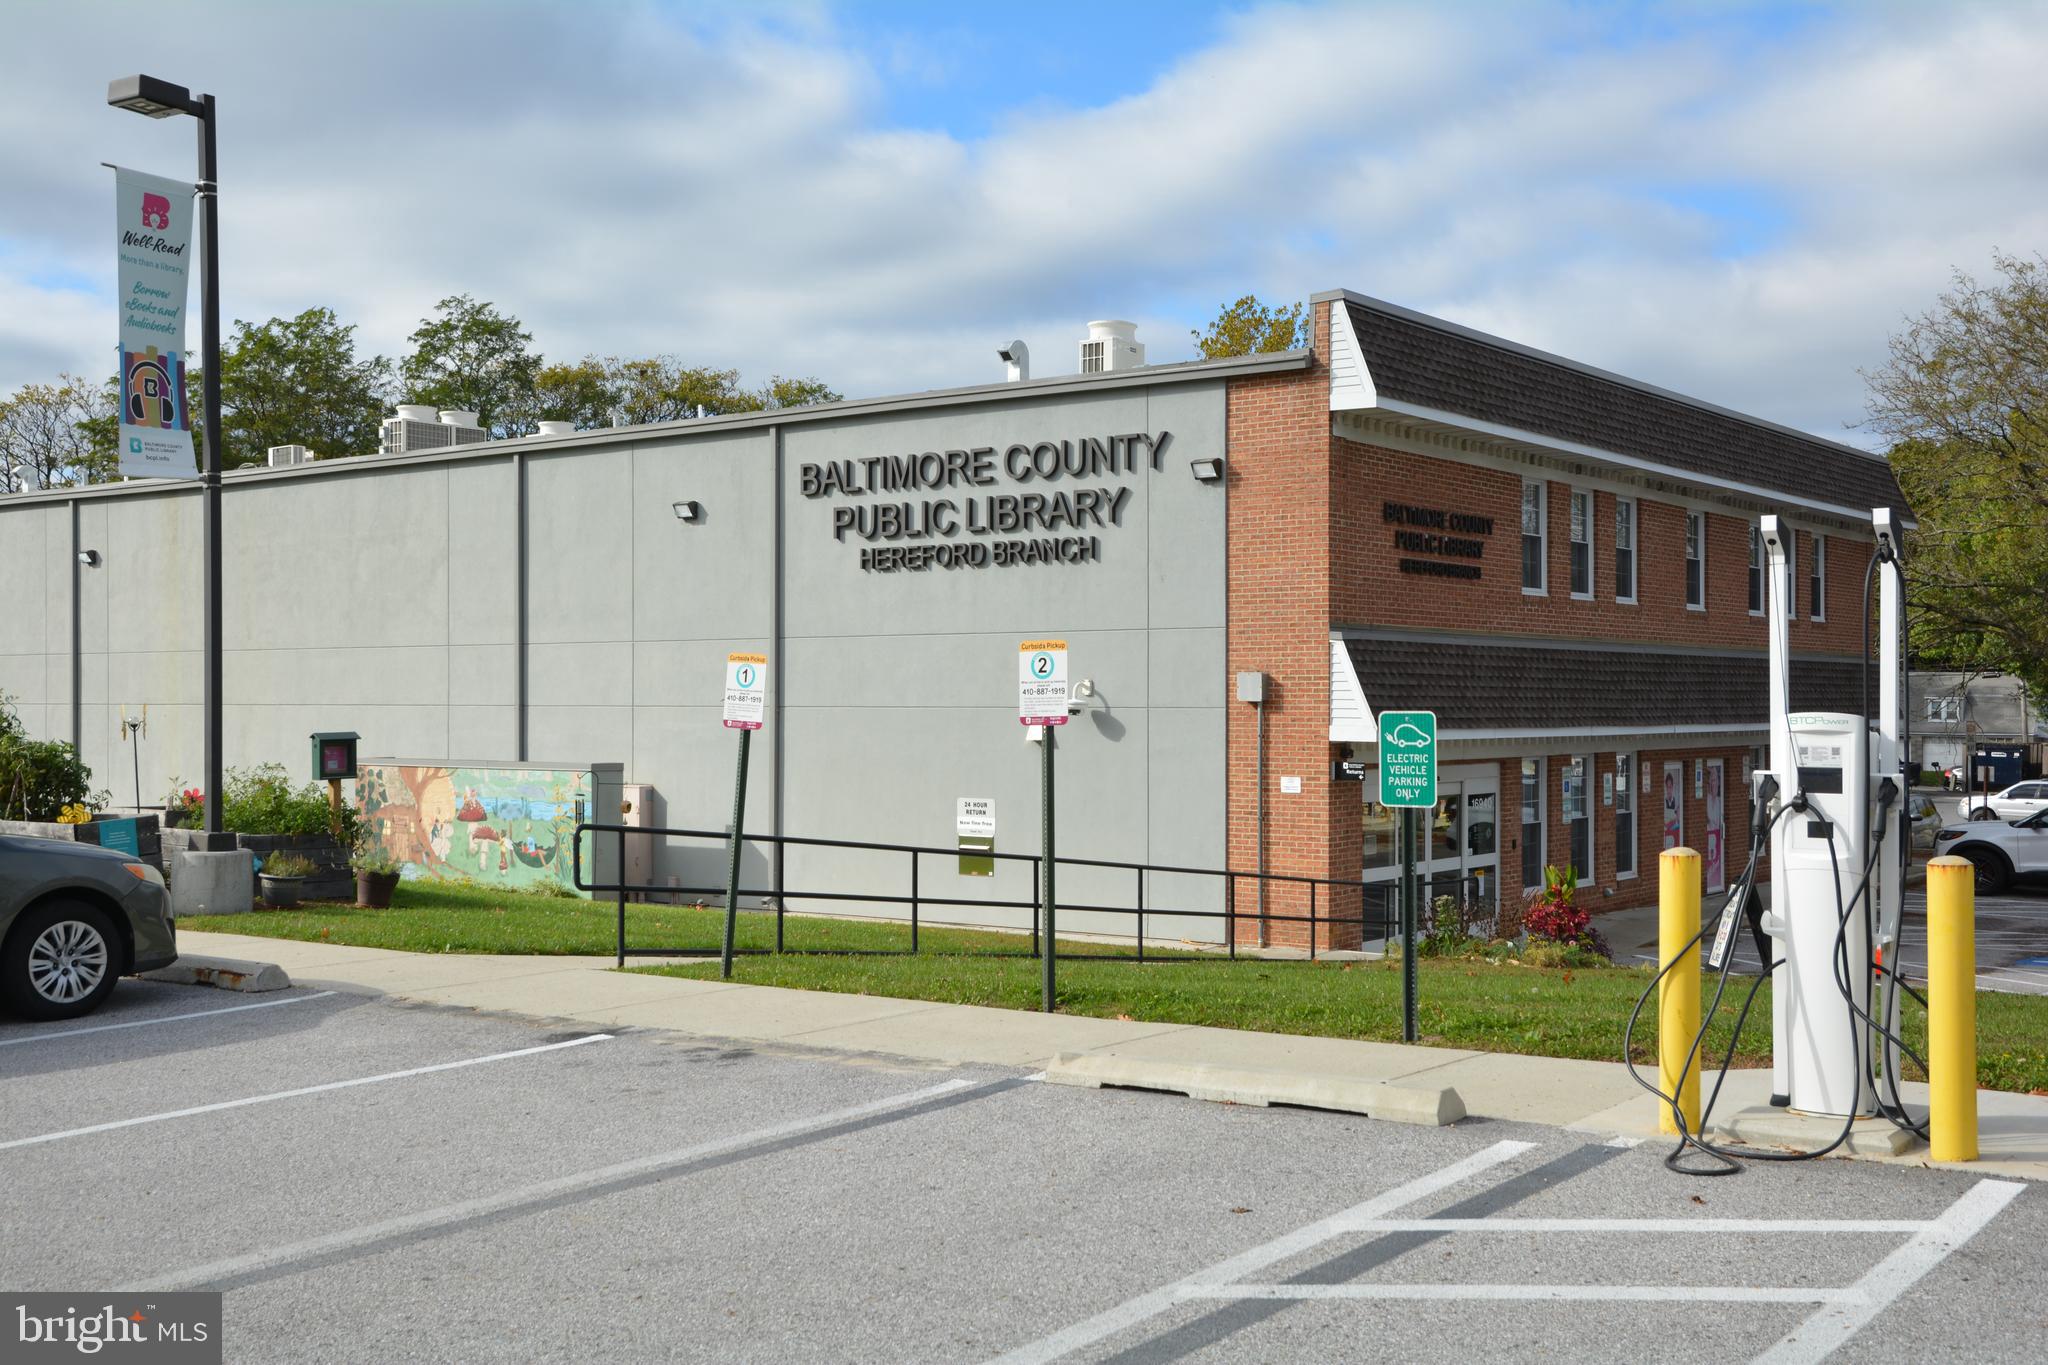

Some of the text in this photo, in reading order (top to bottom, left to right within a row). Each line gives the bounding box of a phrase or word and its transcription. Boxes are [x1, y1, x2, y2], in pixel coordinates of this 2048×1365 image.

[122, 230, 186, 256] Well-Read
[121, 254, 137, 264] More
[139, 258, 154, 268] than
[133, 281, 171, 299] Borrow
[125, 298, 180, 319] eBooks and
[124, 314, 176, 335] Audiobooks
[800, 431, 1170, 498] BALTIMORE COUNTY
[833, 486, 1129, 544] PUBLIC LIBRARY
[860, 536, 1098, 573] HEREFORD BRANCH
[1047, 642, 1066, 650] Pickup
[1038, 657, 1047, 673] 2
[742, 668, 748, 683] 1
[1022, 687, 1065, 696] 410-887-1919
[1387, 754, 1429, 763] ELECTRIC
[1389, 765, 1427, 775] VEHICLE
[1388, 777, 1428, 786] PARKING
[1396, 788, 1421, 798] ONLY
